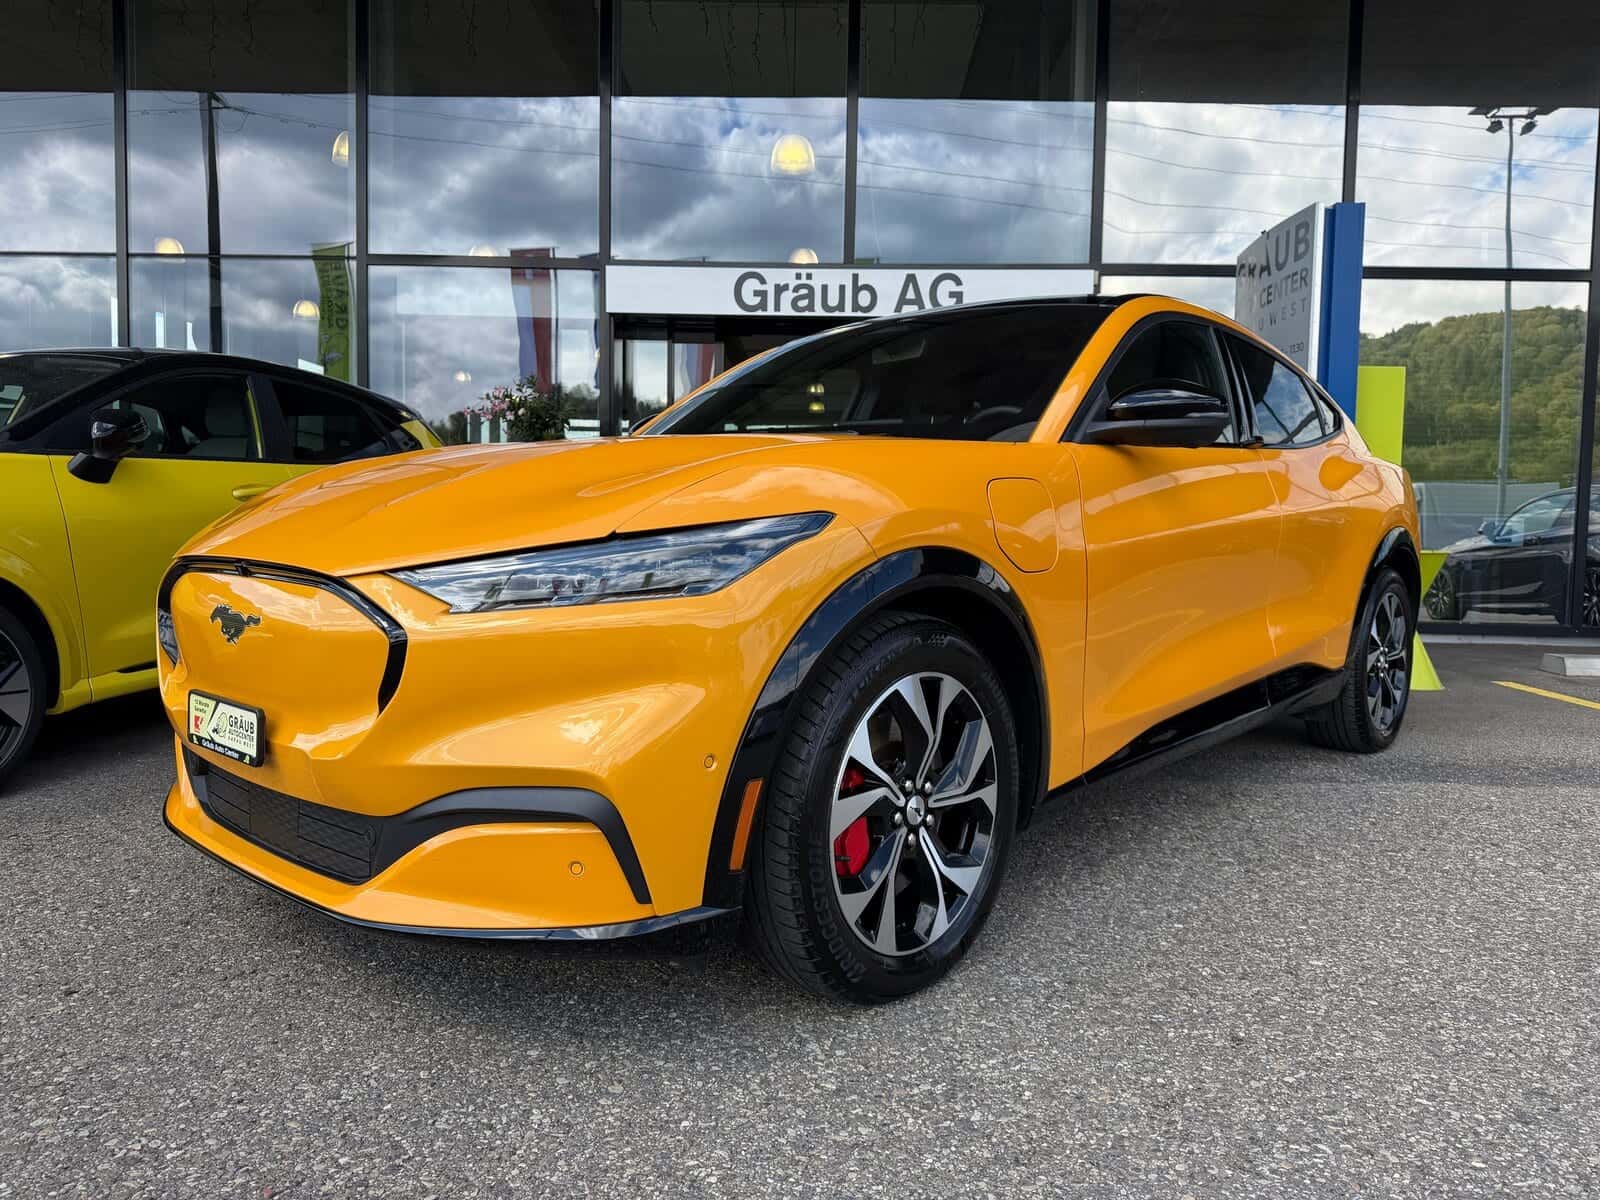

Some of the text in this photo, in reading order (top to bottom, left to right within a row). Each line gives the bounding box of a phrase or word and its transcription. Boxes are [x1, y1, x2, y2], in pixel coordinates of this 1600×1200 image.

[733, 271, 963, 314] Gräub AG
[229, 714, 255, 735] GRÄUB
